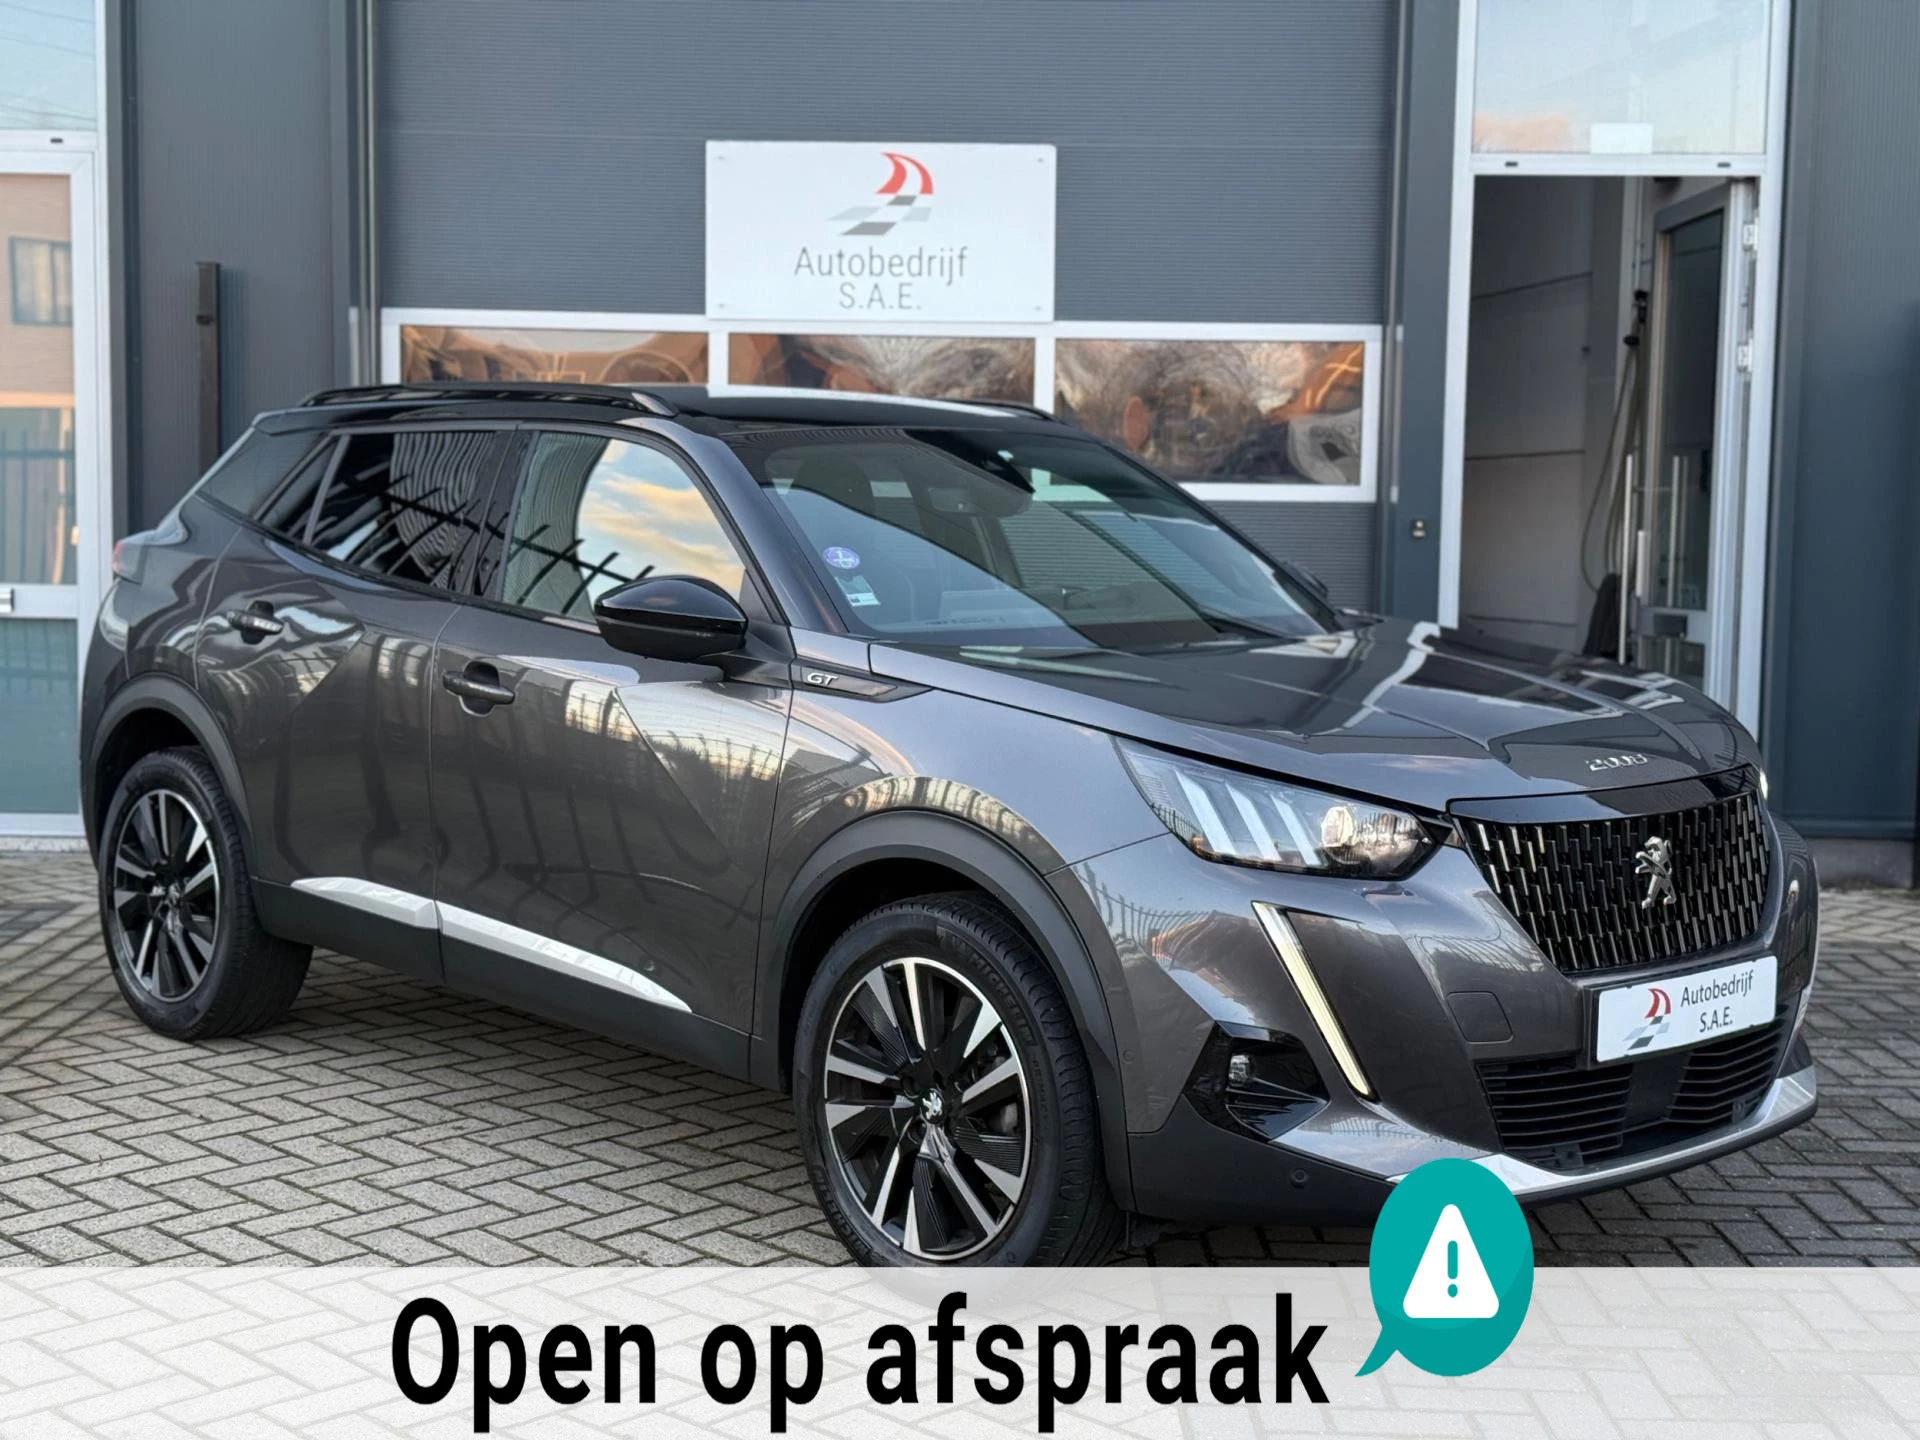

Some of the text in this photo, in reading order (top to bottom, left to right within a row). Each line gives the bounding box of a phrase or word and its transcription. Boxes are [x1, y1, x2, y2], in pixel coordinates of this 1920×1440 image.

[794, 246, 968, 286] Autobedrijf
[839, 283, 921, 310] S.A.E.
[807, 671, 838, 685] GT
[970, 953, 1036, 1046] MICHELIN
[1680, 969, 1754, 1008] Autobedrijf
[1700, 1006, 1733, 1033] S.A.E.
